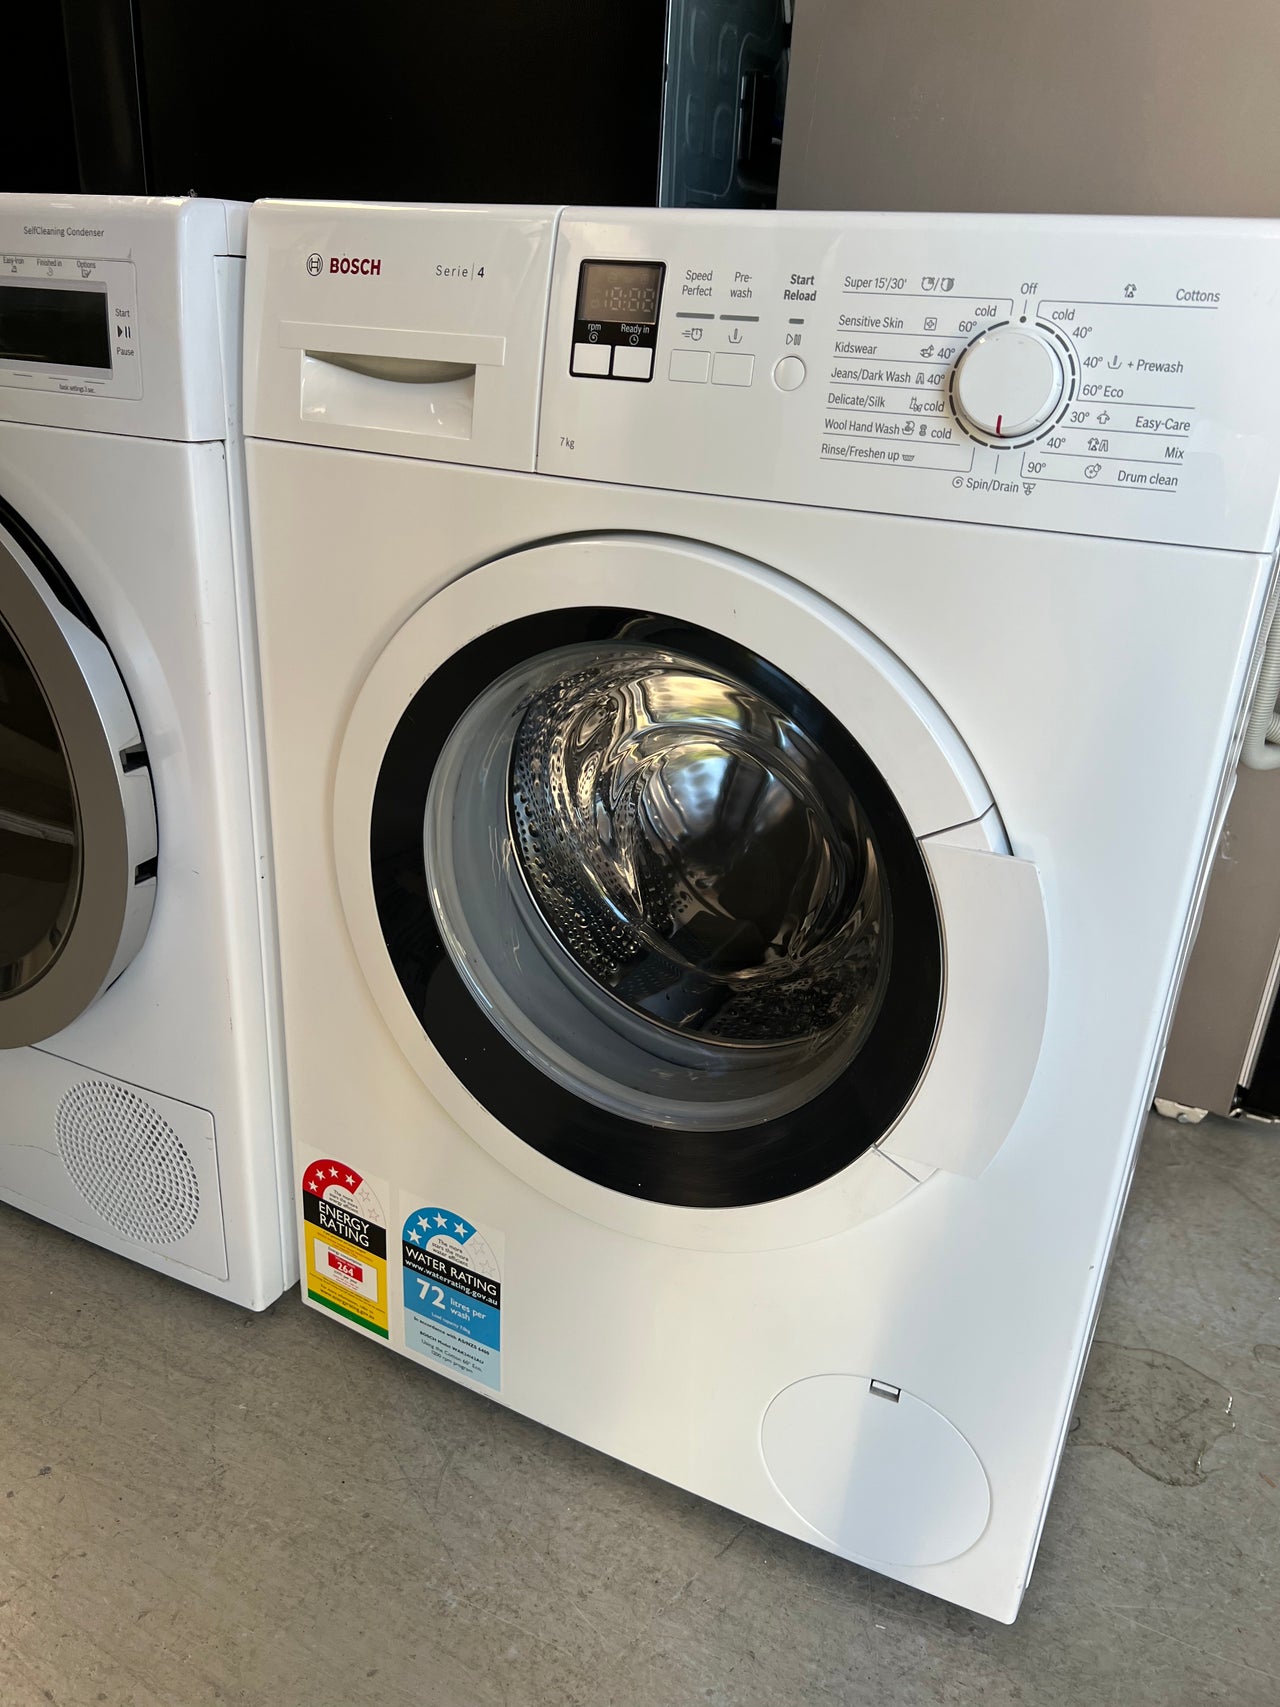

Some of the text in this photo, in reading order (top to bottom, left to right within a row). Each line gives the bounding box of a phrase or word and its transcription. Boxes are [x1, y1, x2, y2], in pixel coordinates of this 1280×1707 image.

[24, 226, 104, 238] SelfCleaning Condenser
[76, 260, 96, 269] Options
[330, 257, 382, 276] BOSCH
[435, 264, 468, 278] Serie
[685, 270, 713, 282] Speed
[734, 271, 752, 283] Pre-
[790, 274, 815, 286] Start
[844, 276, 872, 290] Super
[1020, 282, 1038, 295] Off
[682, 284, 712, 297] Perfect
[730, 287, 752, 299] wash
[783, 290, 816, 301] Reload
[1176, 289, 1220, 302] Cottons
[115, 308, 130, 318] Start
[974, 304, 998, 317] cold
[1052, 309, 1076, 321] cold
[838, 315, 904, 329] Sensitive Skin
[958, 320, 978, 332] 60°
[620, 324, 650, 334] Ready in
[1072, 326, 1092, 338] 40°
[116, 346, 134, 356] Pause
[834, 342, 878, 355] Kidswear
[937, 346, 956, 359] 40°
[1083, 356, 1103, 368] 40°
[1136, 360, 1184, 373] Prewash
[830, 368, 911, 384] Jeans/Dark Wash
[927, 374, 946, 385] 40°
[1082, 384, 1124, 398] 60° Eco
[828, 393, 886, 408] Delicate/Silk
[924, 400, 944, 412] cold
[1070, 412, 1090, 423] 30°
[1135, 416, 1191, 432] Easy-Care
[824, 418, 900, 435] Wool Hand Wash
[930, 428, 952, 440] cold
[560, 437, 576, 450] 7 kg
[1046, 437, 1066, 449] 40°
[821, 444, 900, 462] Rinse/Freshen up
[1164, 447, 1184, 459] Mix
[1027, 462, 1046, 474] 90°
[1118, 470, 1178, 486] Drum clean
[966, 477, 1019, 493] Spin/Drain
[318, 1200, 370, 1234] ENERGY
[320, 1214, 370, 1248] RATING
[438, 1238, 462, 1254] The more
[405, 1246, 448, 1274] WATER
[454, 1252, 468, 1262] more
[337, 1262, 354, 1276] 264
[404, 1259, 498, 1306] www.waterrating.gov.au
[450, 1266, 497, 1296] RATING
[416, 1278, 446, 1310] 72
[450, 1297, 486, 1320] litres per
[450, 1308, 470, 1322] wash
